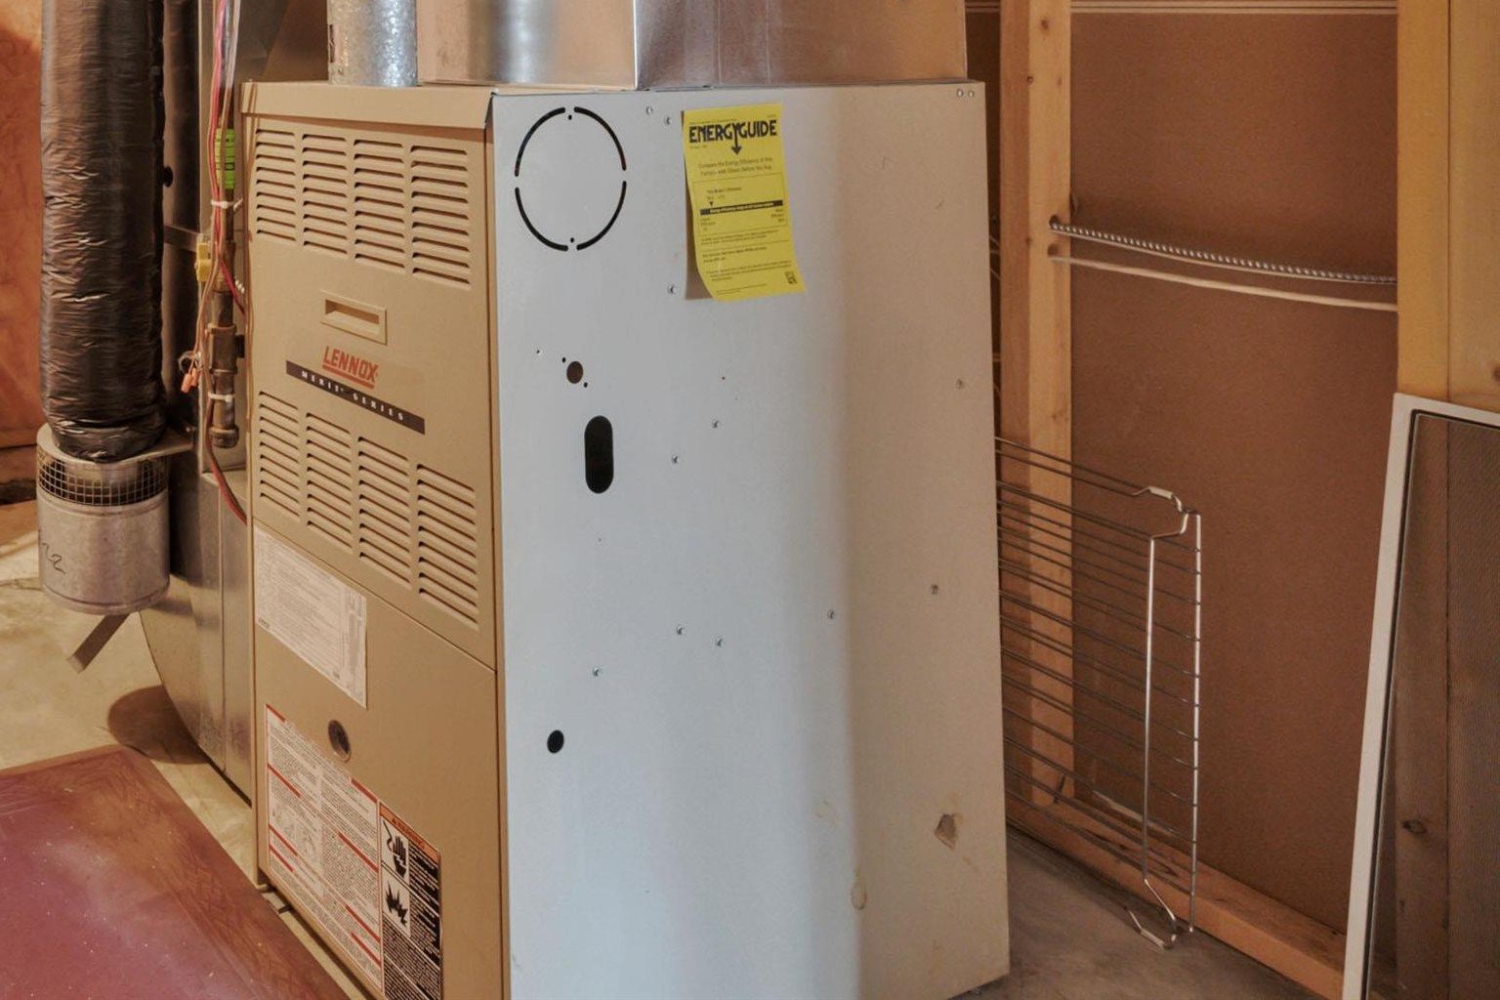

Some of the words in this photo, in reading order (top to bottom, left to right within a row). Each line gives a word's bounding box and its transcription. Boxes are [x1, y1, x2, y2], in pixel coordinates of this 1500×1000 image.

[688, 119, 777, 143] ENERGYGUIDE
[323, 345, 379, 384] LENNOX
[301, 370, 341, 393] MERIT
[353, 392, 404, 421] SERIES
